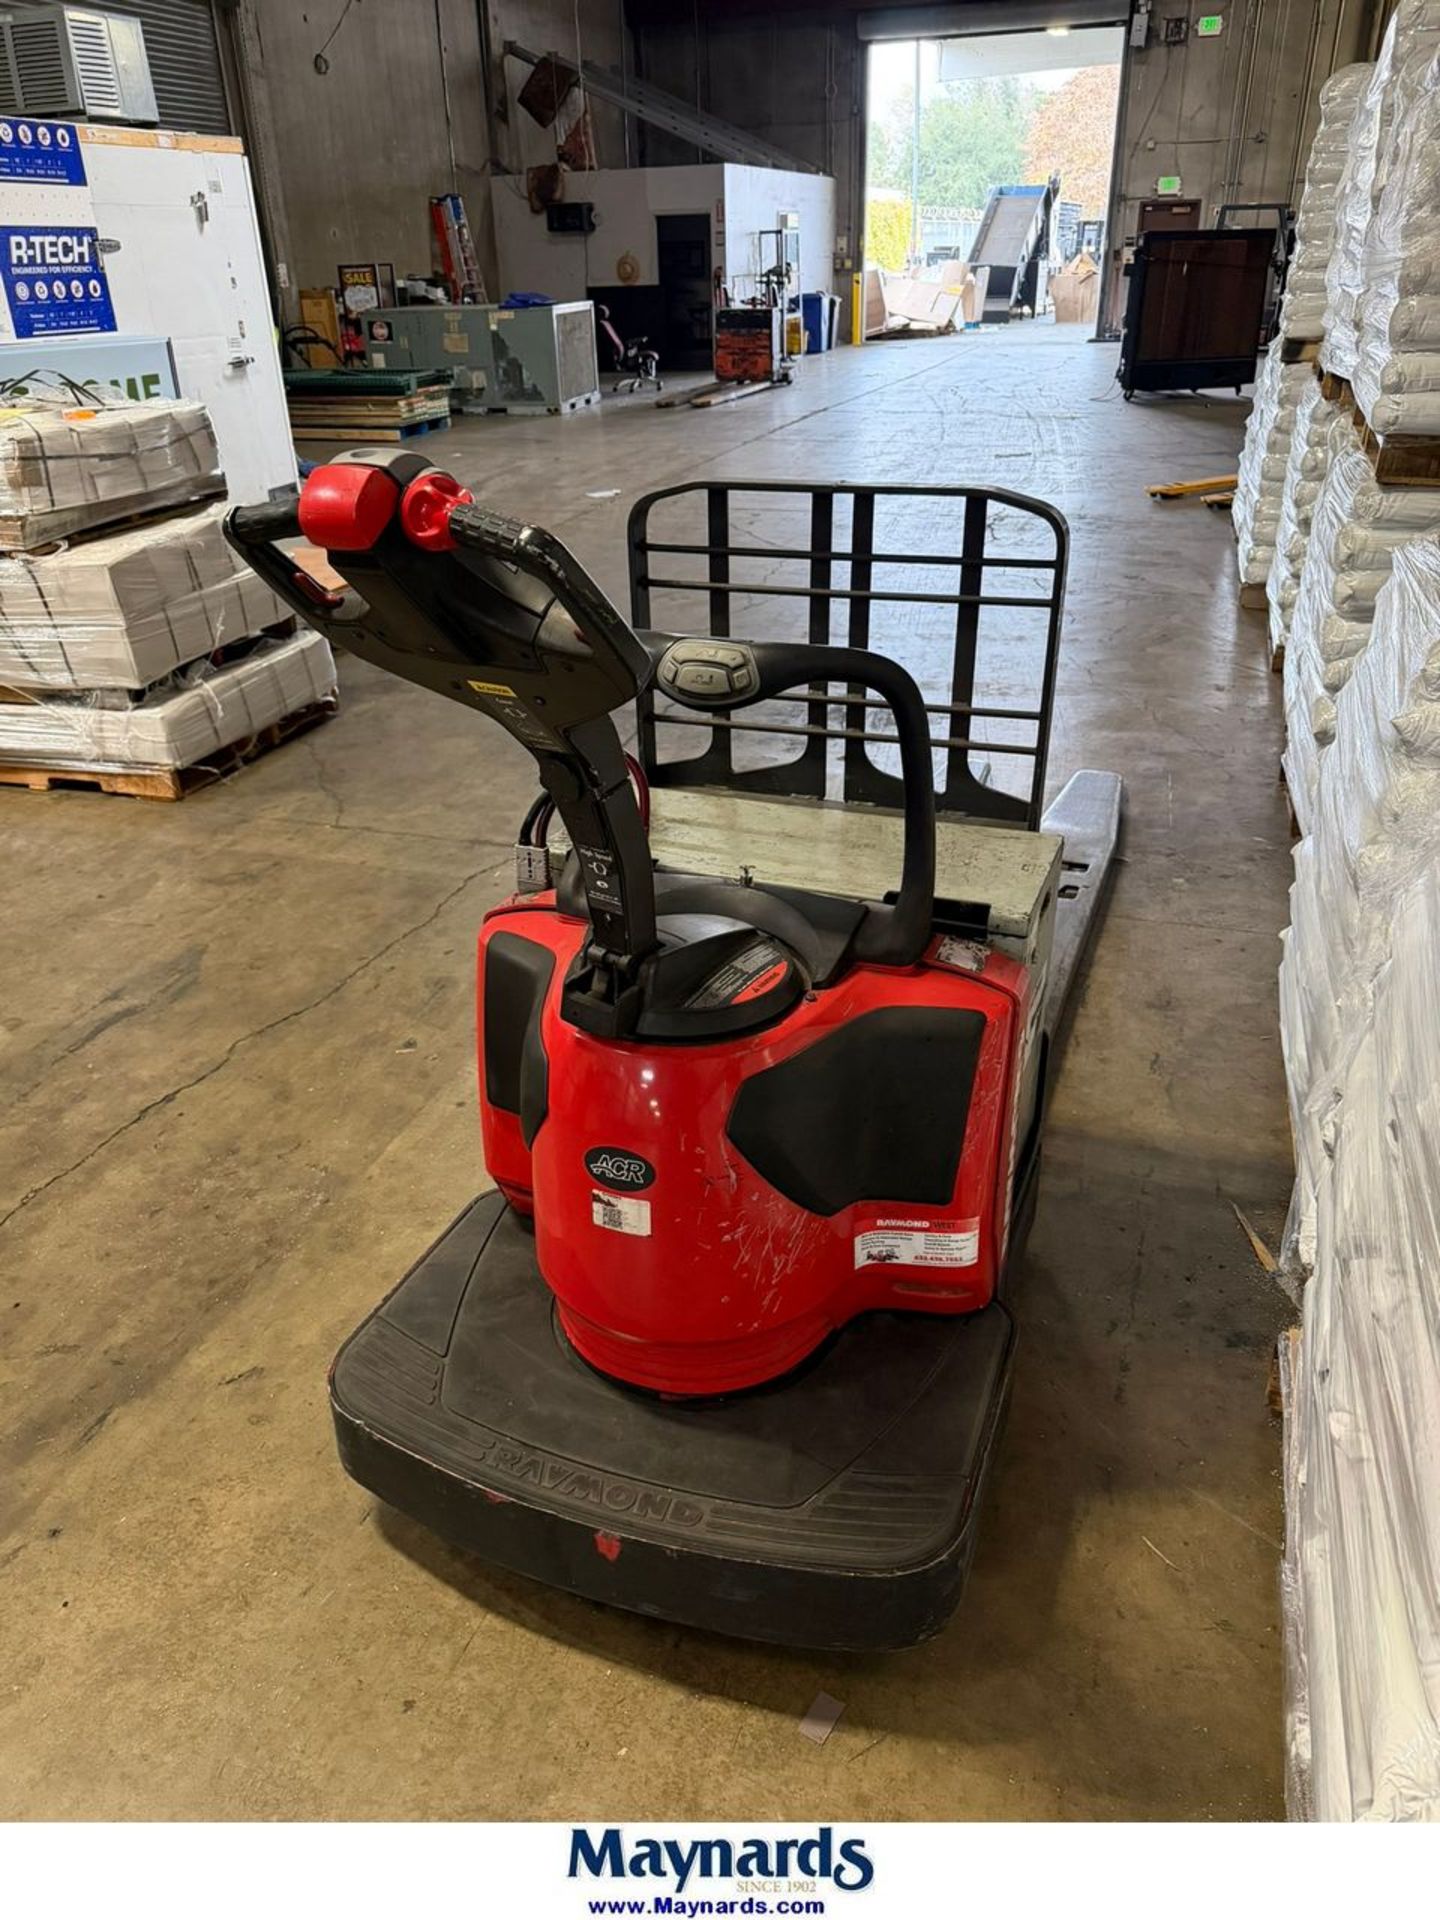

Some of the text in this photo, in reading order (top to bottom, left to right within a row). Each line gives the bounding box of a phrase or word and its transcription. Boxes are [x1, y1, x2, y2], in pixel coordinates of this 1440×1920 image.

[10, 235, 90, 264] R-TECH
[11, 266, 48, 275] ENGINEERED
[49, 266, 60, 274] FOR
[344, 272, 374, 284] SALE
[590, 1154, 646, 1184] ACR
[876, 1219, 930, 1228] RAYMOND
[489, 1447, 704, 1527] RAYMOND
